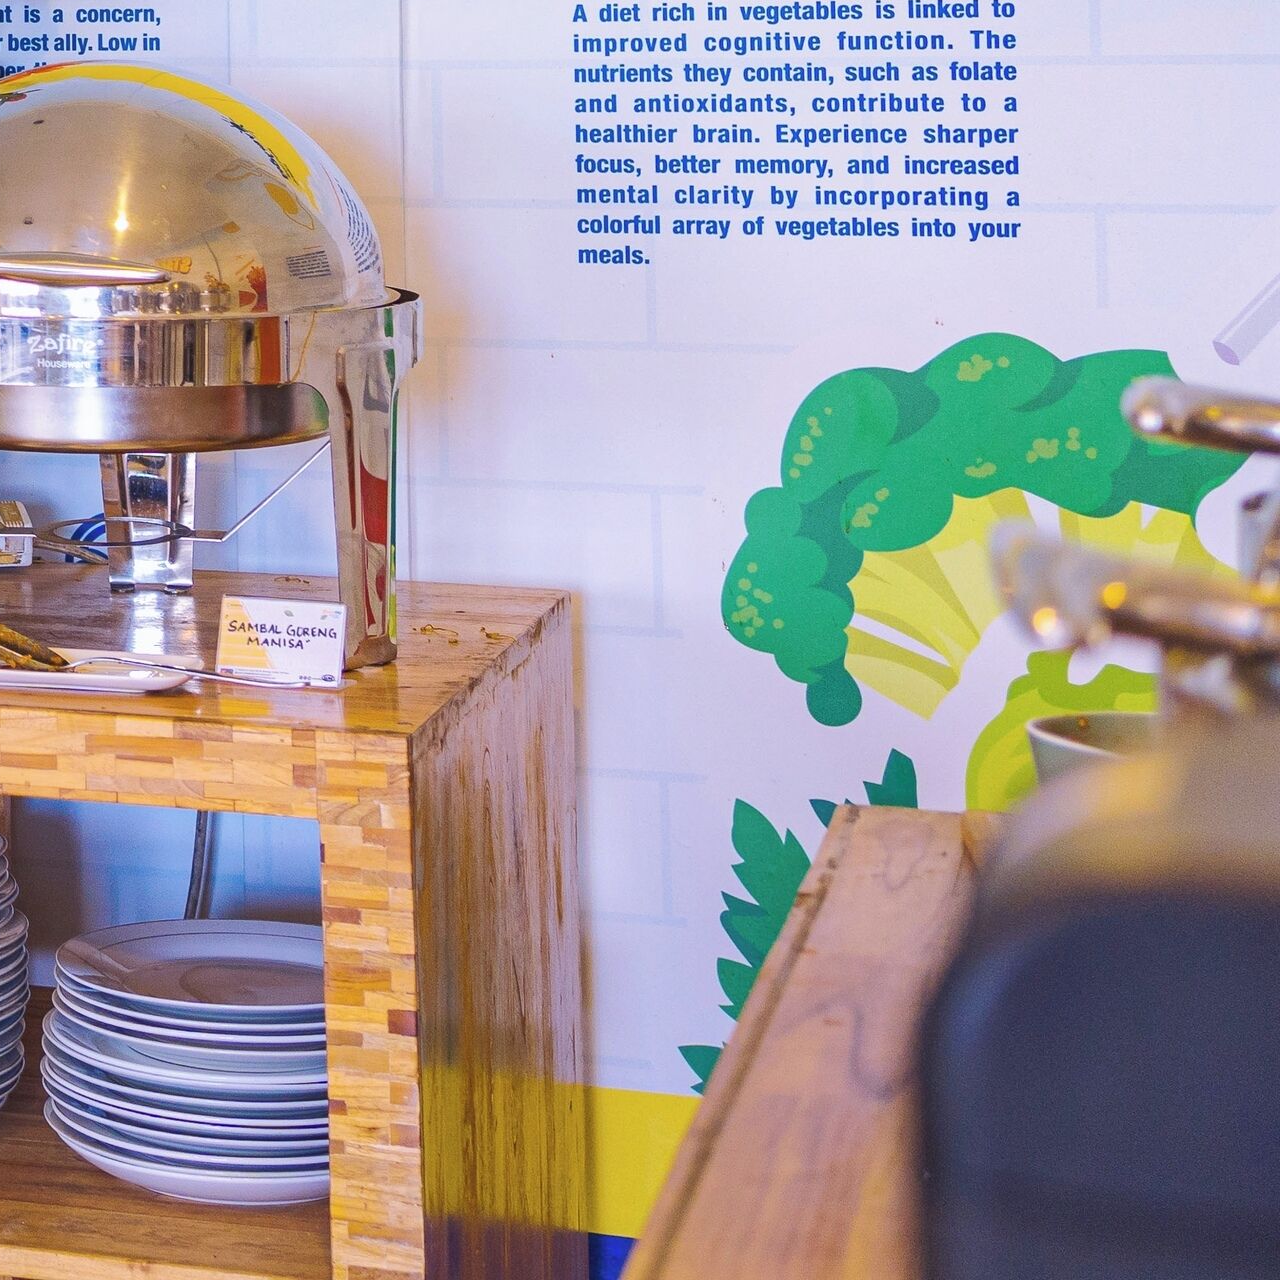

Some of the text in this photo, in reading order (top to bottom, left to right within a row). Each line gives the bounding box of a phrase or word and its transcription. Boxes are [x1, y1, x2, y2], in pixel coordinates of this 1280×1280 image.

[23, 5, 161, 26] is a concern,
[572, 4, 588, 23] A
[599, 3, 641, 23] diet
[652, 2, 695, 22] rich
[707, 2, 727, 21] in
[739, 0, 863, 25] vegetables
[875, 0, 895, 19] is
[7, 33, 161, 55] best ally. Low in
[573, 30, 1017, 57] improved cognitive function. The
[574, 61, 1017, 86] nutrients they contain, such as folate
[574, 92, 1017, 117] and antioxidants, contribute to a
[575, 124, 1019, 148] healthier brain. Experience sharper
[575, 153, 1019, 179] focus, better memory, and increased
[577, 184, 1020, 211] mental clarity by incorporating a
[577, 214, 1021, 242] colorful array of vegetables into your
[578, 245, 650, 265] meals.
